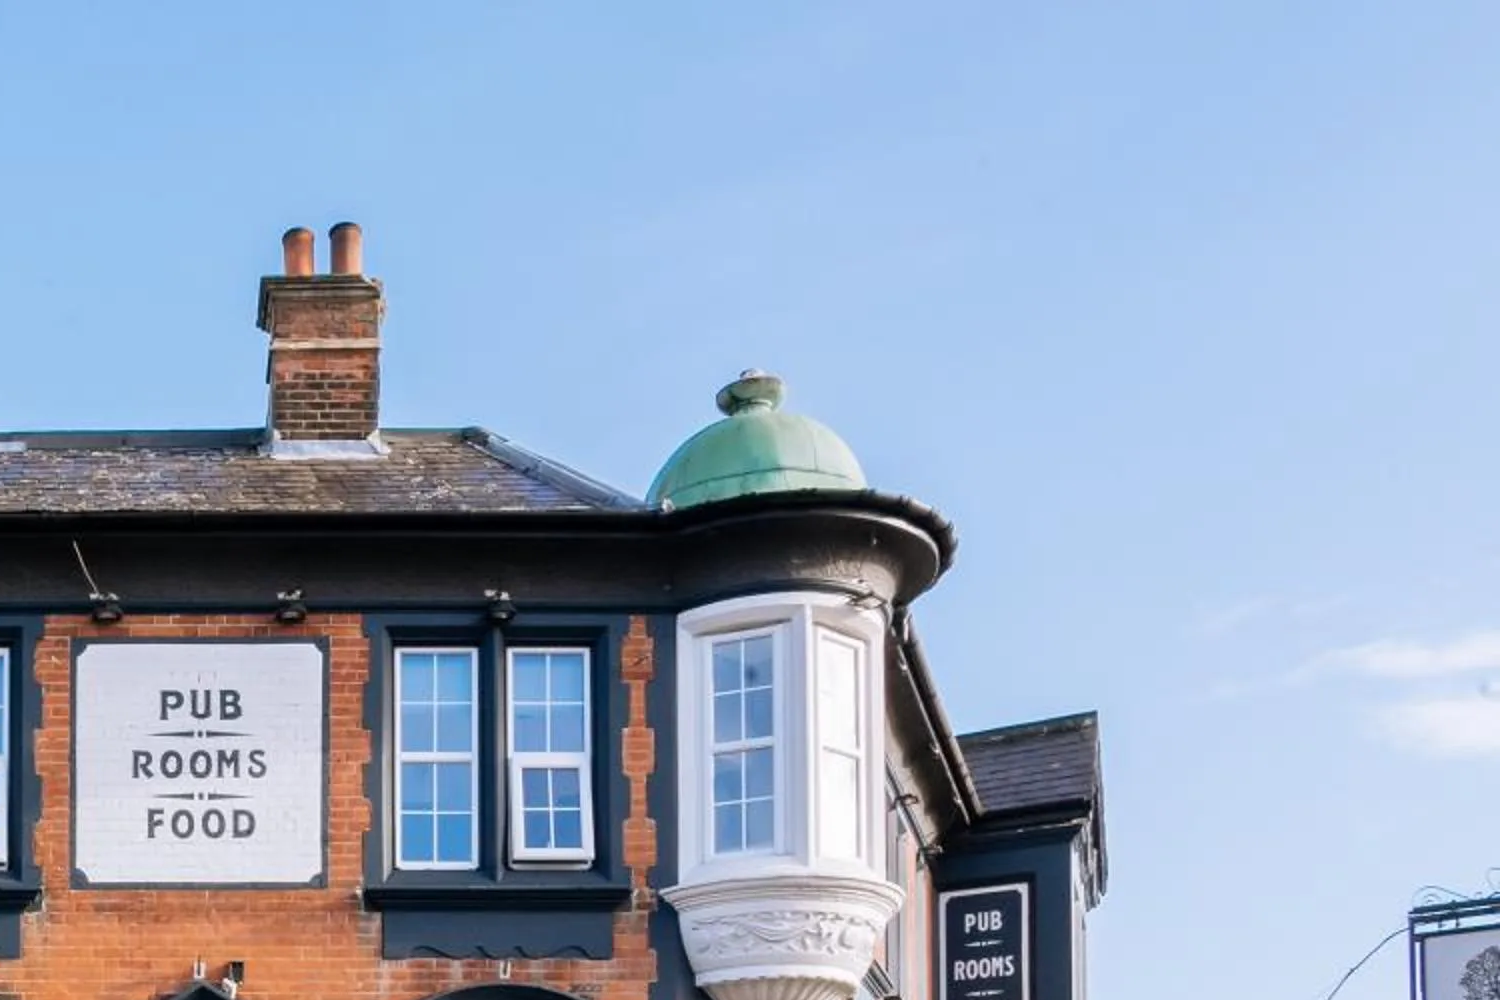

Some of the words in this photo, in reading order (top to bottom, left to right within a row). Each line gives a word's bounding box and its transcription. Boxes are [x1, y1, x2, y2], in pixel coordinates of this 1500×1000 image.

[160, 689, 243, 721] PUB
[132, 749, 267, 779] ROOMS
[147, 808, 256, 839] FOOD
[964, 910, 1003, 934] PUB
[954, 955, 1015, 981] ROOMS
